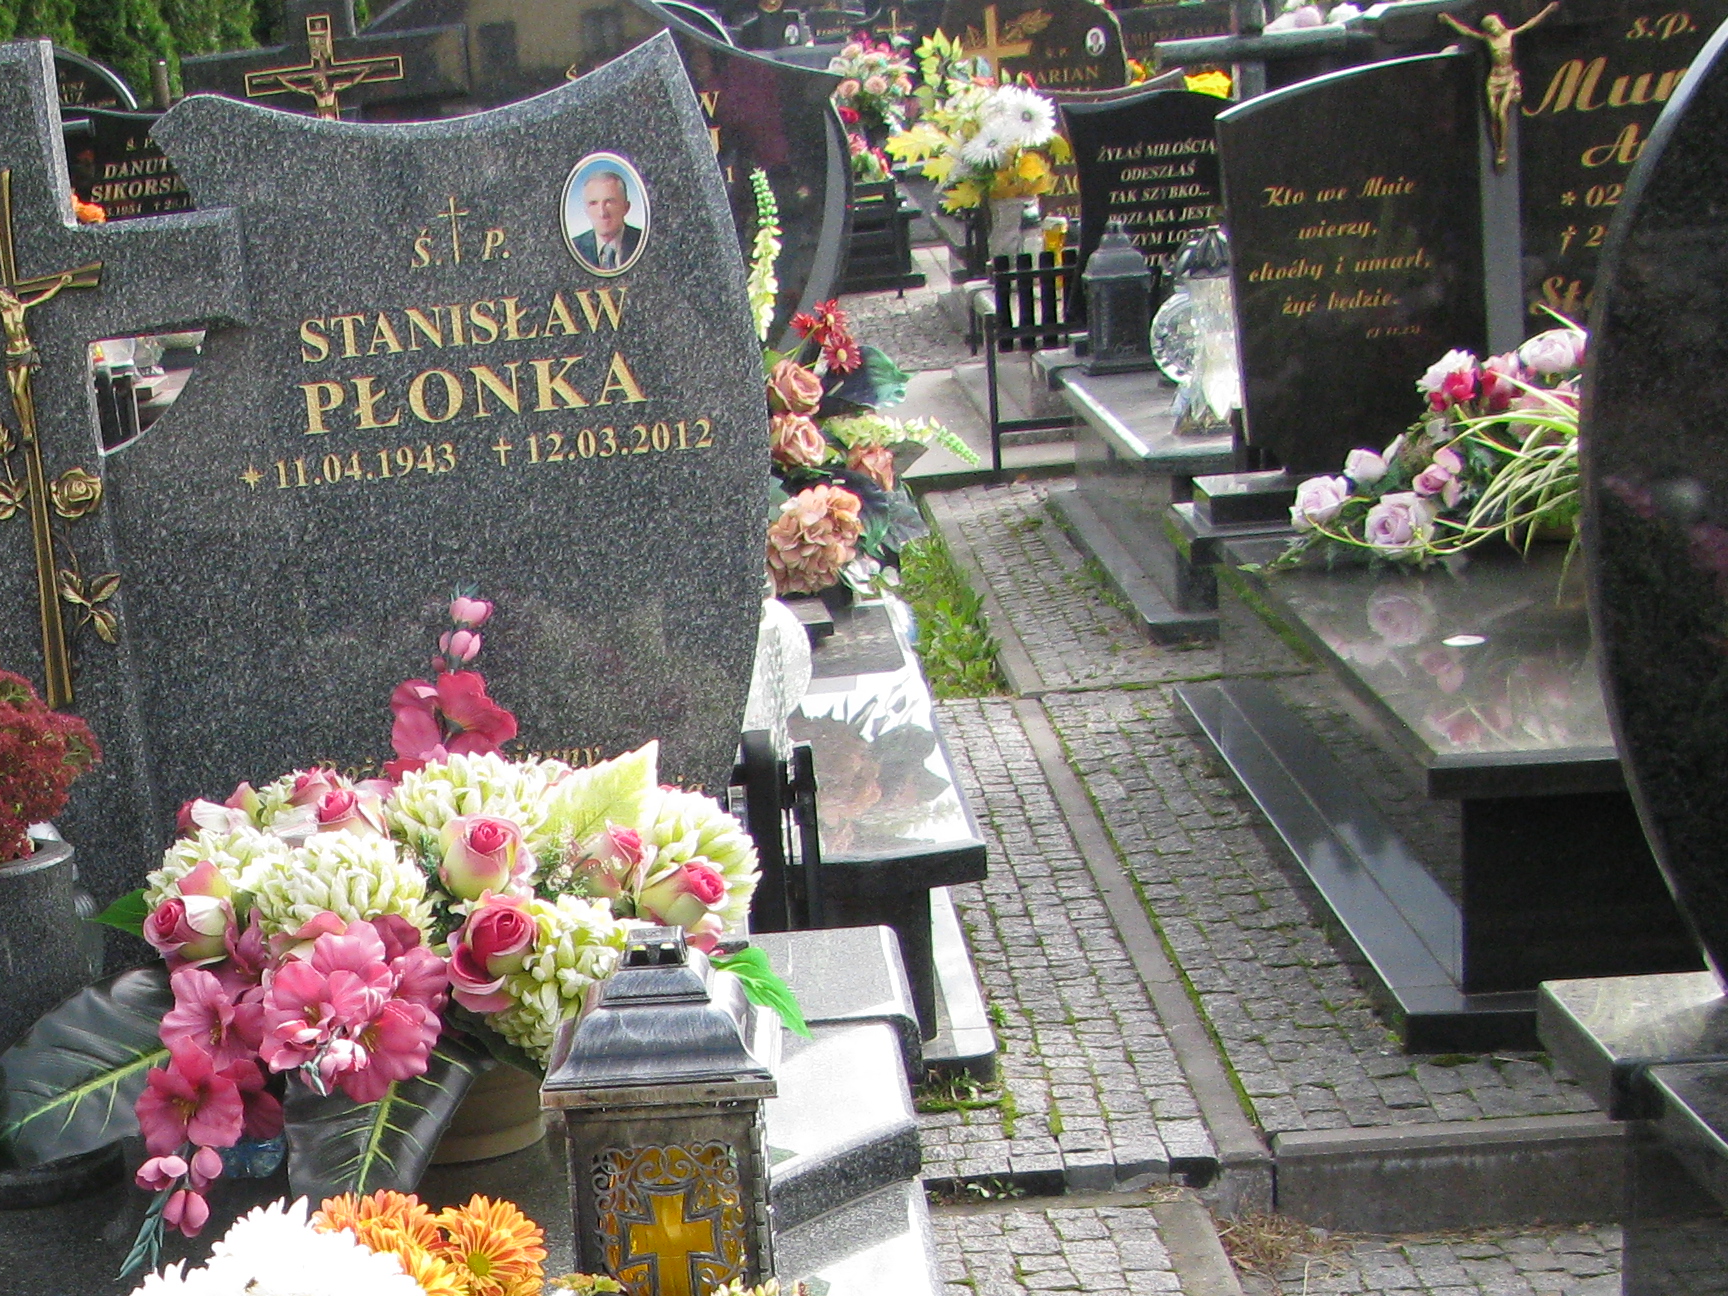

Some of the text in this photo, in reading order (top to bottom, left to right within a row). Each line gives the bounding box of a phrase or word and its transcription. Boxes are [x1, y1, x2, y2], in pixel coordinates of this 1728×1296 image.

[1036, 64, 1100, 84] ARIAN
[103, 156, 169, 179] DANUT
[90, 175, 189, 203] SIKORSK
[1109, 188, 1138, 204] TAK
[1261, 175, 1417, 208] Kto we Mnie
[1180, 204, 1215, 221] JEST
[299, 286, 630, 364] STANISŁAW
[297, 350, 648, 436] PŁONKA
[274, 417, 715, 491] 11.04.1943 12.03.2012
